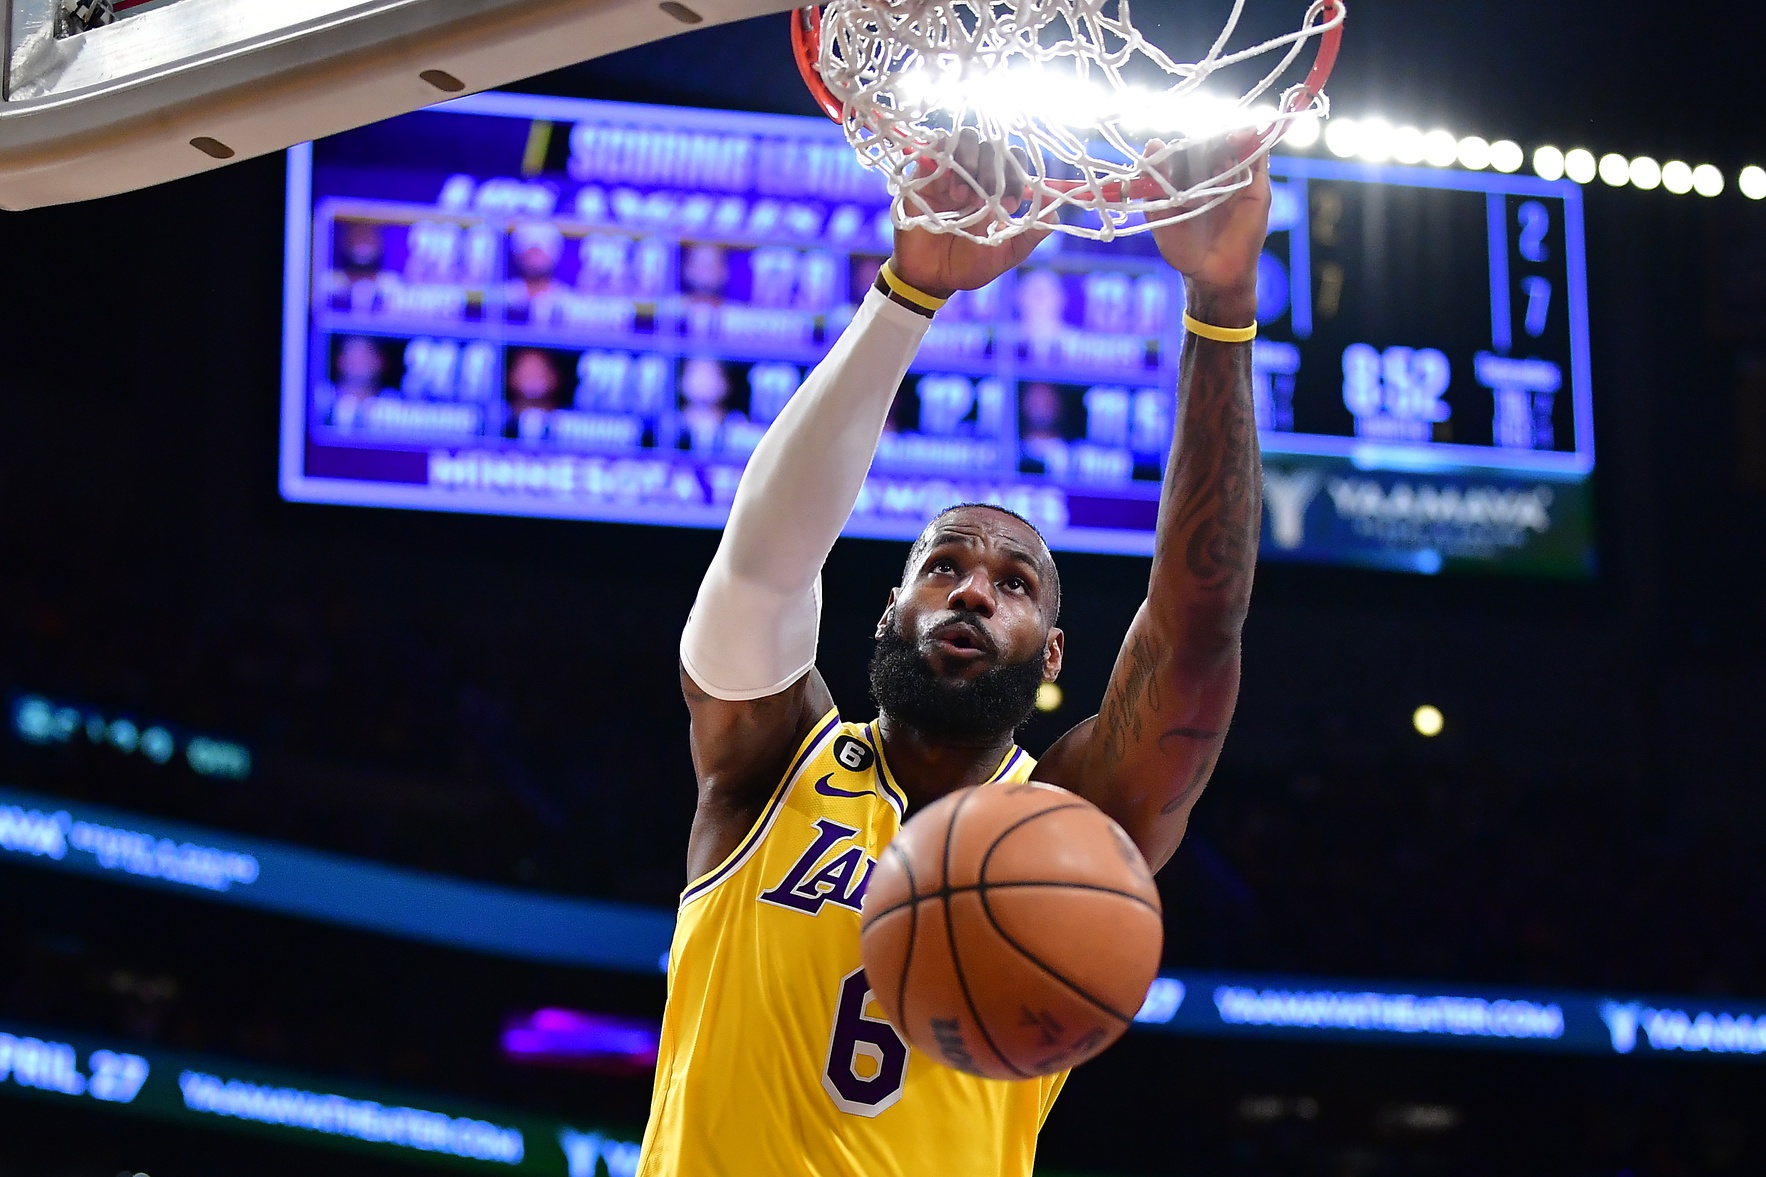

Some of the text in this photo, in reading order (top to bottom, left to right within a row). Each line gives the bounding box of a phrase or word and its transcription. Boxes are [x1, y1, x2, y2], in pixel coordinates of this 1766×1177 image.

[1516, 201, 1549, 263] 2
[1519, 276, 1552, 338] 7
[839, 741, 866, 768] 6
[821, 963, 911, 1118] 6
[88, 1049, 150, 1104] 27
